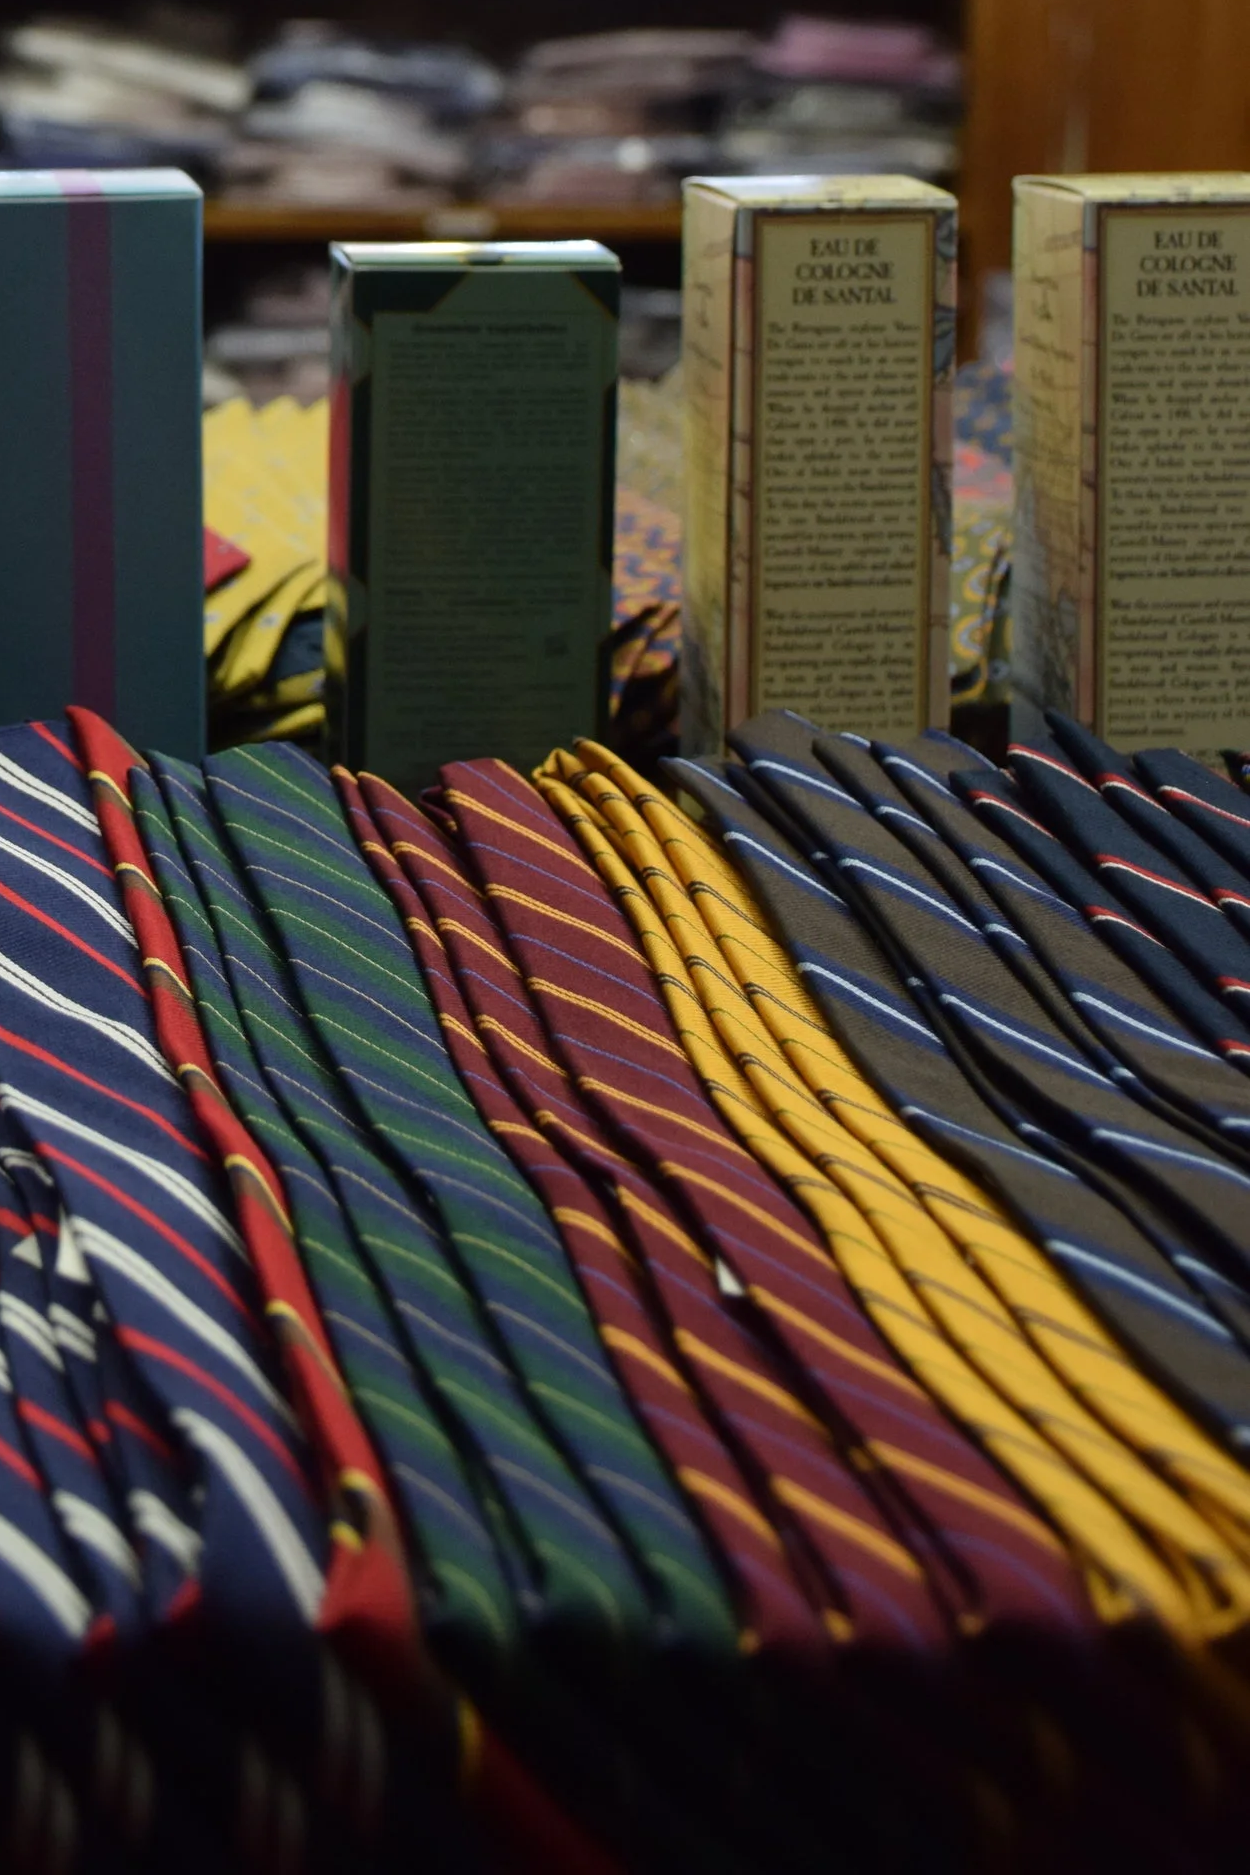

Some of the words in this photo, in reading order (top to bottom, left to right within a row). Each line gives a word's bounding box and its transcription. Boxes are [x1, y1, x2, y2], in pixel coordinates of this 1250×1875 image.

[810, 238, 849, 258] EAU
[854, 237, 880, 257] DE
[1154, 231, 1192, 250] EAU
[1197, 230, 1223, 250] DE
[795, 261, 894, 281] COLOGNE
[1139, 253, 1237, 274] COLOGNE
[792, 286, 818, 306] DE
[822, 286, 898, 305] SANTAL
[1136, 279, 1162, 298] DE
[1167, 278, 1240, 298] SANTAL
